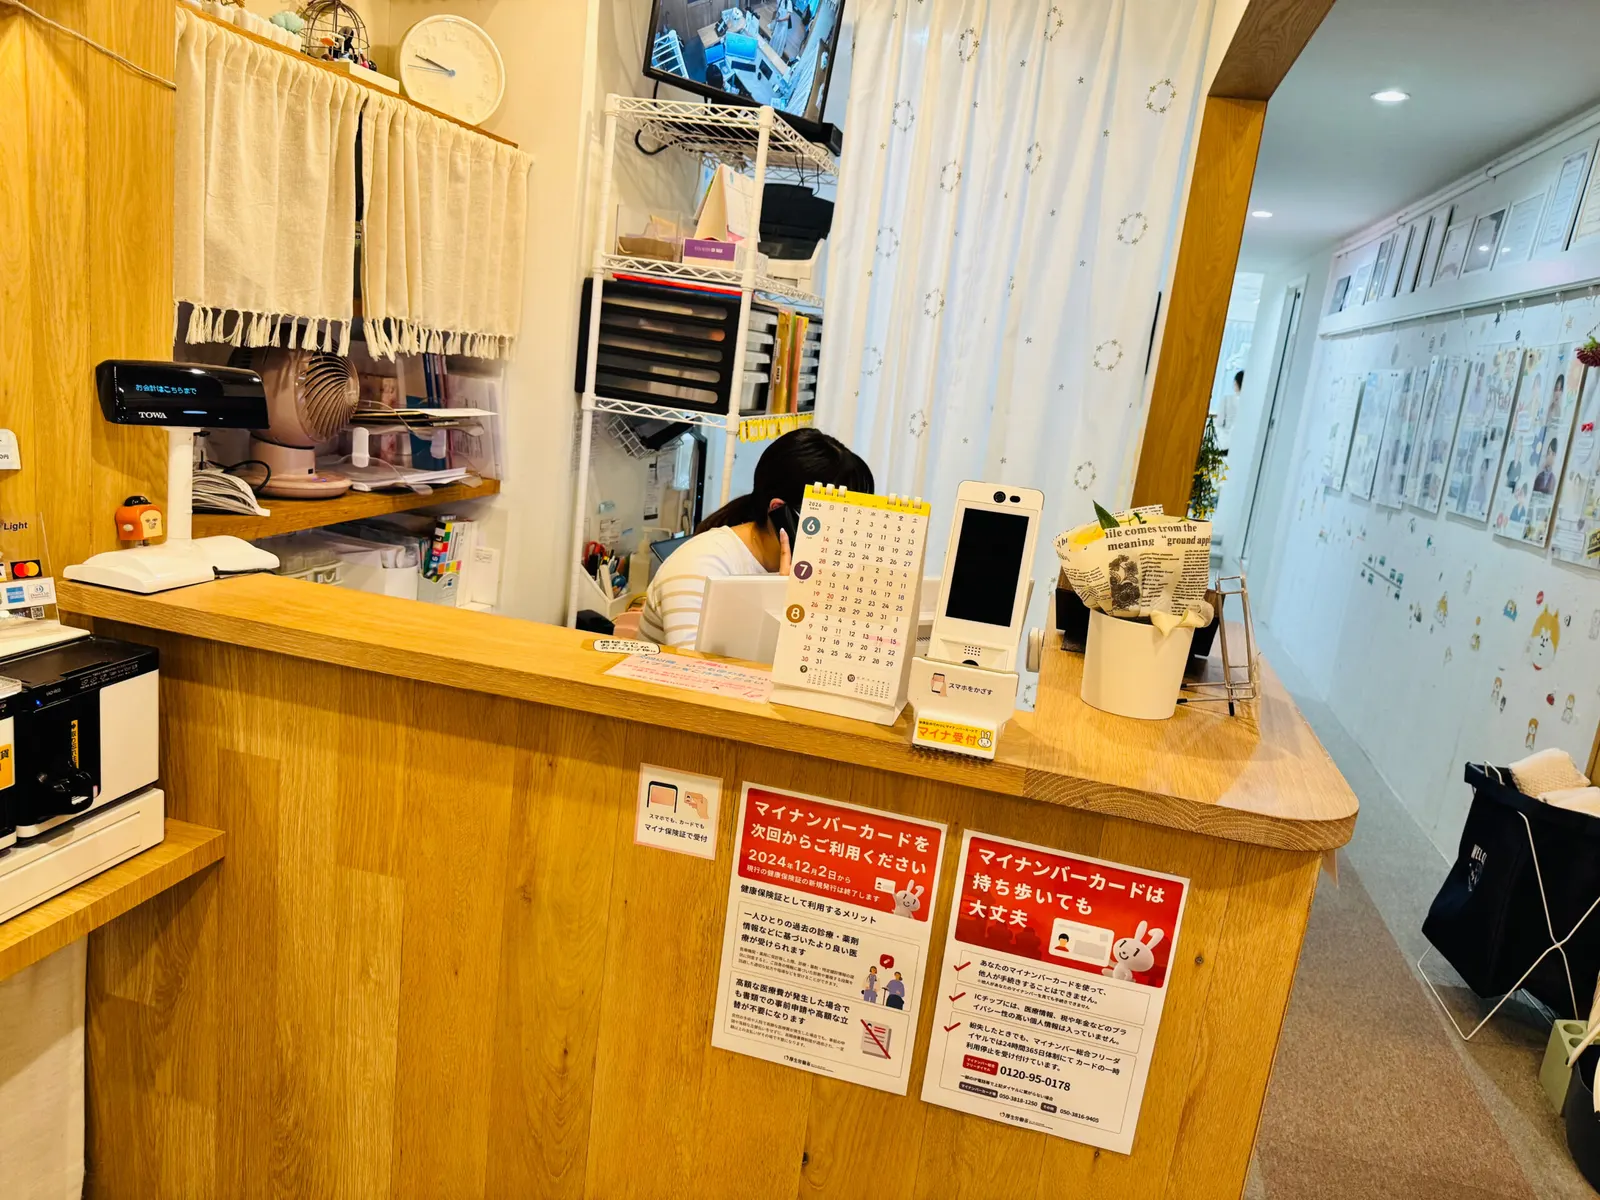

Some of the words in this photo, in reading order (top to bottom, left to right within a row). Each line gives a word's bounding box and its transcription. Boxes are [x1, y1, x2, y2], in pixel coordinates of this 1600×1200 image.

[135, 384, 197, 395] お会計はこちらまで
[807, 500, 822, 508] 2026
[4, 522, 28, 531] Light
[806, 519, 816, 532] 6
[1125, 526, 1157, 536] comes
[1183, 523, 1197, 532] the
[1108, 537, 1154, 551] meaning
[799, 563, 809, 577] 7
[790, 607, 800, 620] 8
[949, 682, 993, 695] スマホをかざす
[918, 726, 977, 746] マイナ受付
[645, 823, 708, 843] マイナ保険証で受付
[649, 813, 705, 829] スマホでも、カードでも
[754, 800, 930, 853] マイナンバーカードを
[750, 822, 926, 875] 次回からご利用ください
[747, 848, 851, 884] 2024年12月2日から
[978, 847, 1165, 903] マイナンバーカードは
[739, 883, 876, 924] 健康保険証として利用するメリット
[971, 871, 1092, 915] 持ち歩いても
[967, 898, 1028, 928] 大丈夫
[741, 920, 858, 958] 情報などに基づいたより良い医
[743, 911, 859, 946] 一人ひとりの過去の診療・薬剤
[740, 933, 806, 956] 療が受けられます
[977, 968, 1098, 1005] 他人が手続きすることはできません。
[979, 958, 1106, 996] あなたのマイナンバーカードを使って、
[734, 977, 850, 1014] 高額な医療費が発生した場合で
[734, 988, 849, 1025] も書類での事前申請や高額な立
[732, 999, 806, 1025] 替が不要になります
[972, 1003, 1119, 1045] イバシー性の高い個人情報は入っていません。
[973, 992, 1127, 1036] ICチップには、医療情報、税や年金などのプラ
[965, 1040, 1060, 1072] 利用停止を受け付けています。
[968, 1020, 1121, 1064] 紛失したときでも、マイナンバー総合フリーダ
[999, 1065, 1071, 1092] 0120-95-0178
[1075, 1058, 1120, 1076] カードの一時
